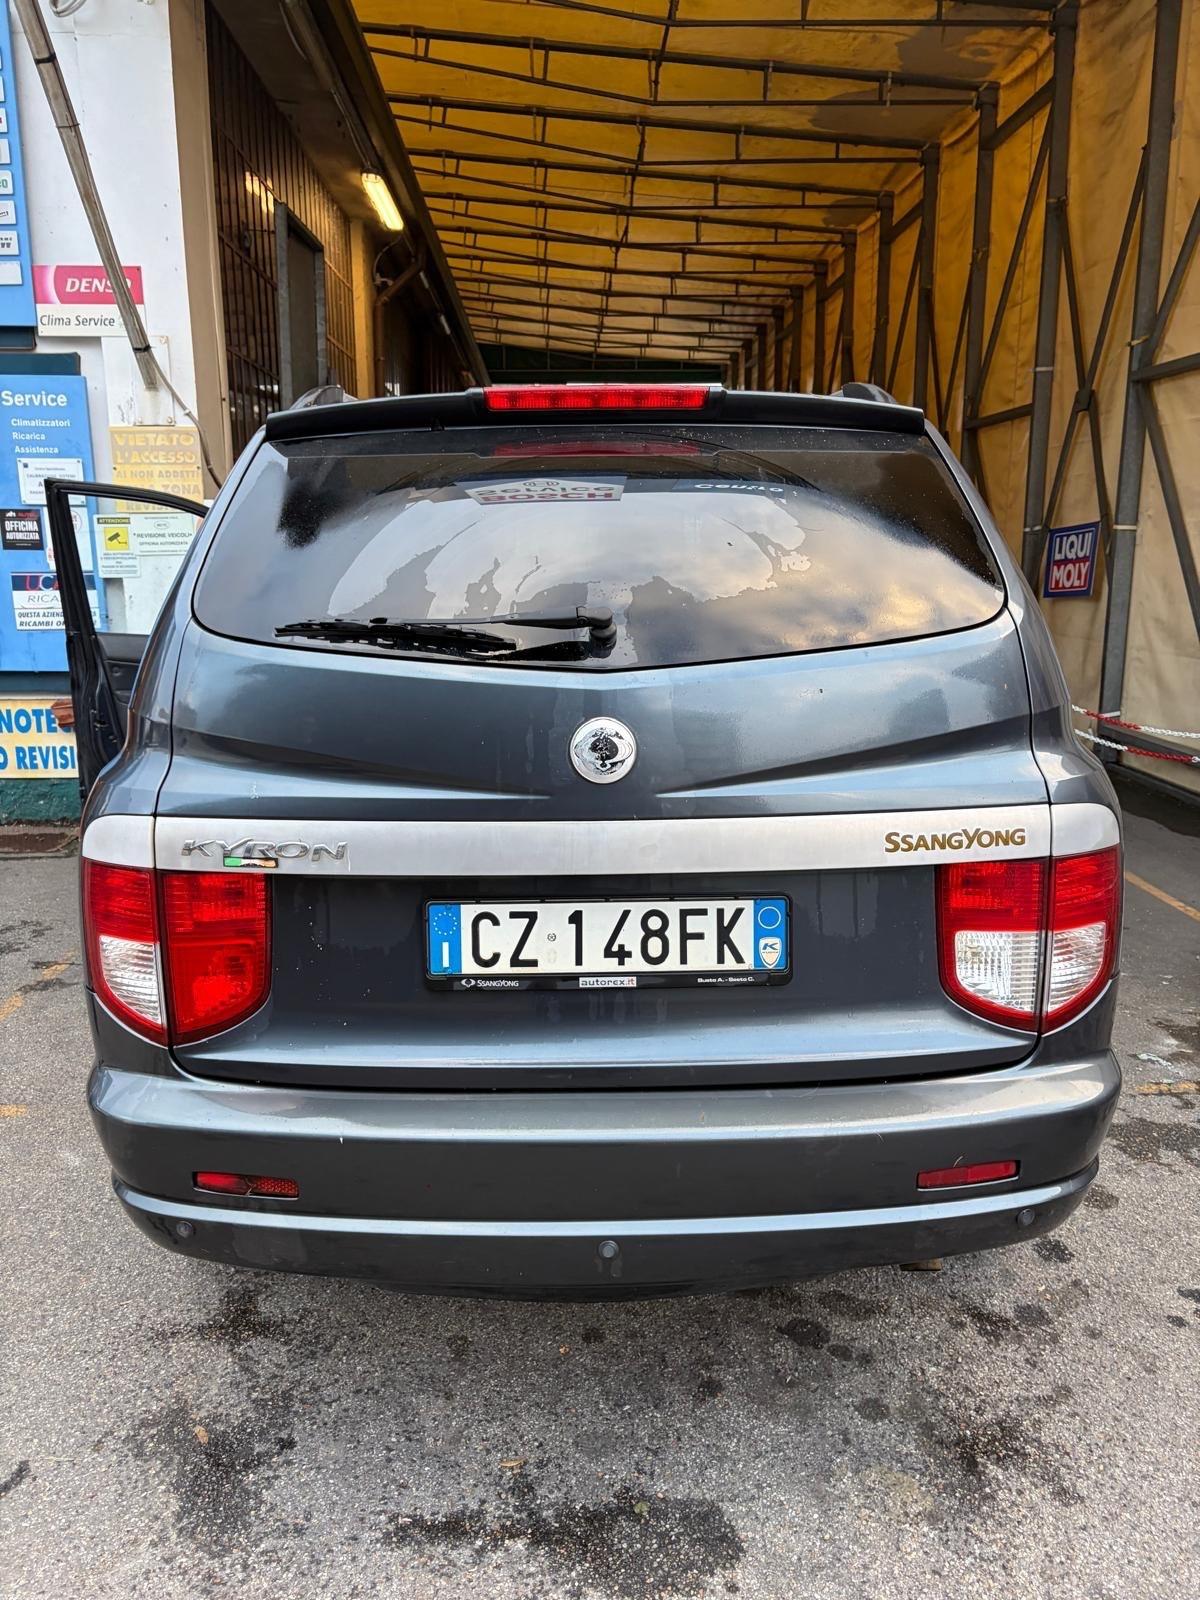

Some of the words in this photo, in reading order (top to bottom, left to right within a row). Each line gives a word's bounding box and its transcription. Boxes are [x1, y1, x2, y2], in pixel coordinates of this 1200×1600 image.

[65, 277, 132, 293] DENS
[40, 315, 71, 326] Clima
[74, 315, 115, 327] Service
[1, 390, 68, 407] Service
[11, 418, 71, 427] Climatizzatori
[12, 431, 46, 440] Ricarica
[114, 433, 194, 446] VIETATO
[15, 445, 59, 454] Assistenza
[131, 470, 154, 478] NON
[158, 469, 200, 478] ADDETTI
[5, 520, 39, 531] OFFICINA
[6, 532, 40, 540] AUTORIZZATA
[1054, 532, 1092, 560] LIQUI
[1051, 562, 1090, 588] MOLY
[15, 746, 76, 770] REVISI
[181, 838, 348, 862] KYRON
[580, 977, 636, 987] autorex.it
